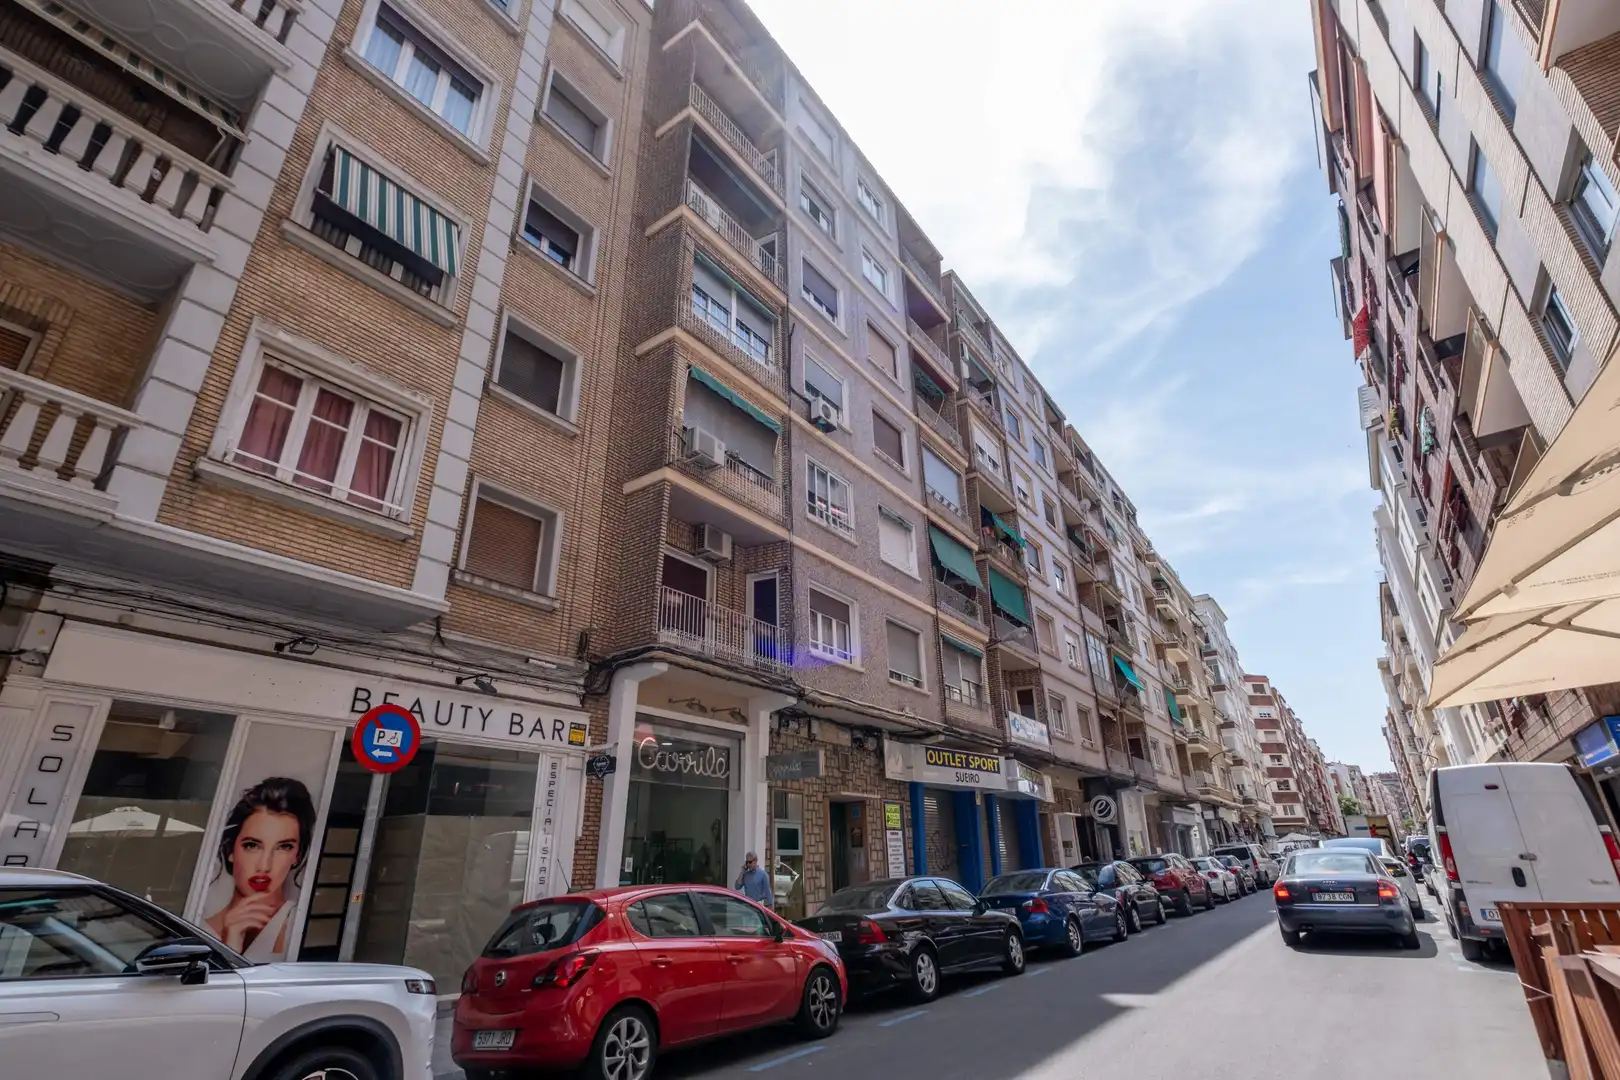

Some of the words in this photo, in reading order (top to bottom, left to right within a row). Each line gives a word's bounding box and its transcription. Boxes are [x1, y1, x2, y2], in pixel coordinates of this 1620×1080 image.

[376, 730, 386, 744] P
[509, 713, 565, 742] BAR
[926, 750, 967, 768] OUTLET
[969, 755, 999, 772] SPORT
[955, 771, 980, 784] SUEIRO
[4, 725, 75, 867] SOLAR
[538, 762, 558, 885] ESPECIALISTAS
